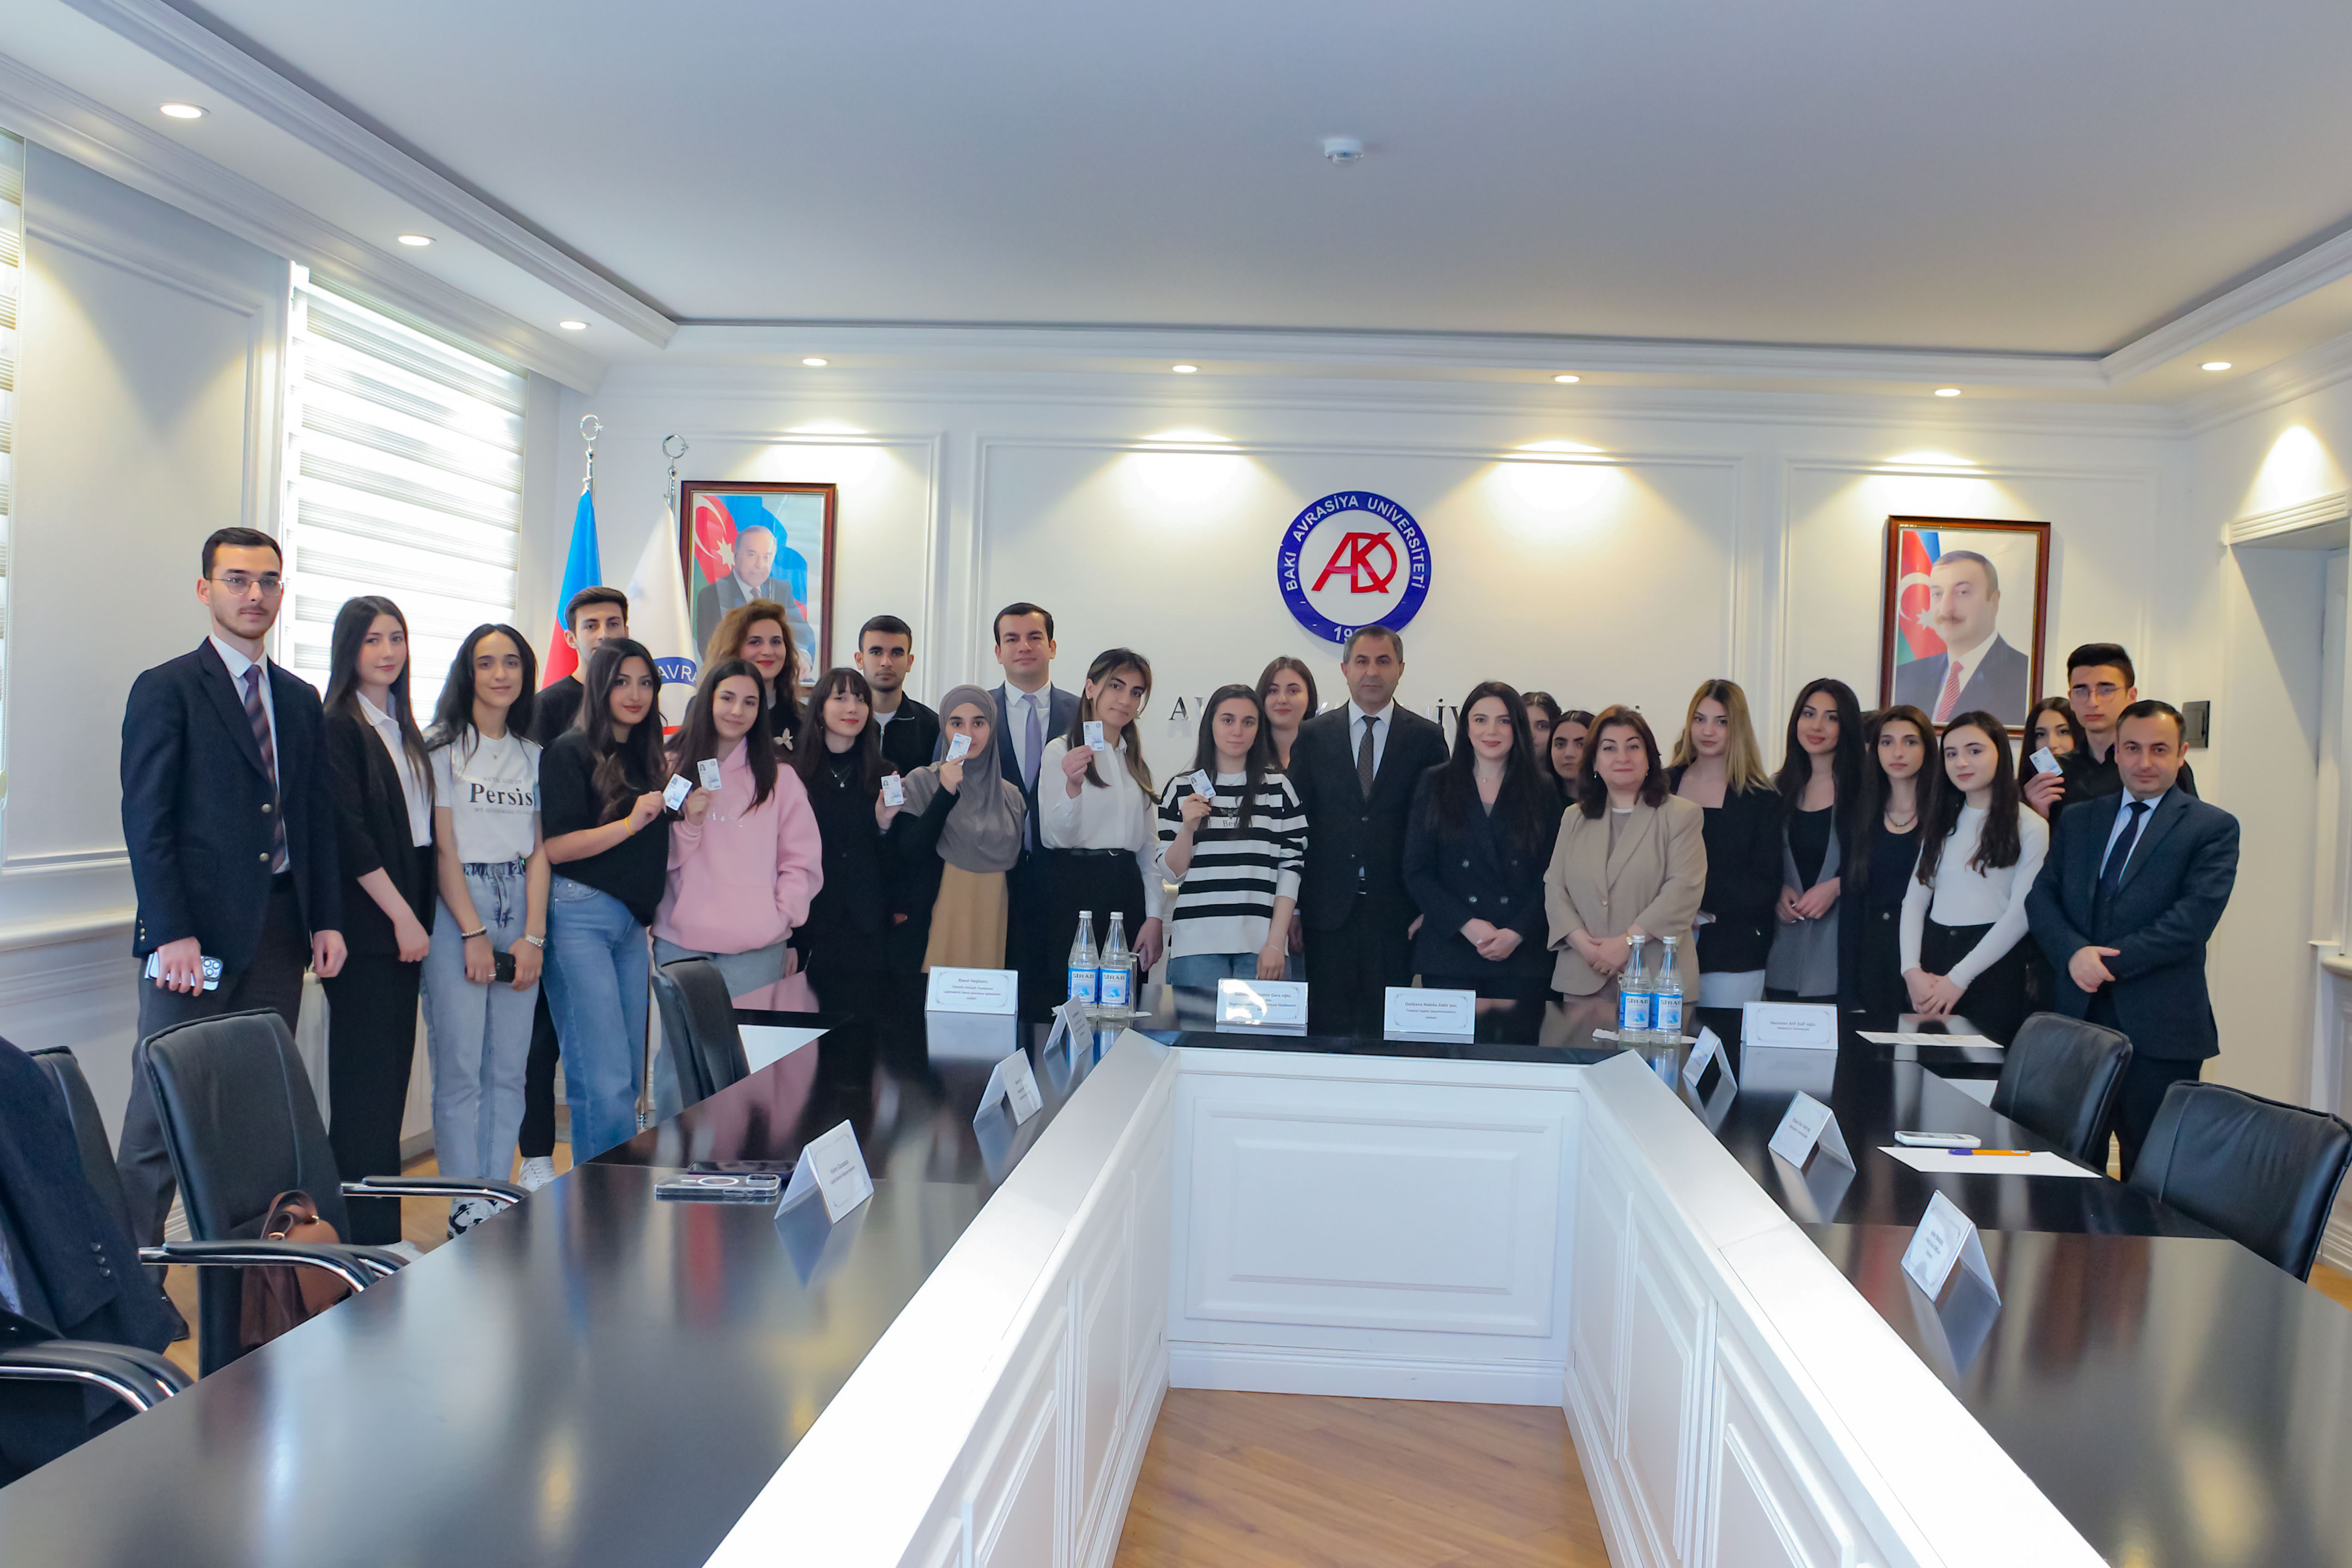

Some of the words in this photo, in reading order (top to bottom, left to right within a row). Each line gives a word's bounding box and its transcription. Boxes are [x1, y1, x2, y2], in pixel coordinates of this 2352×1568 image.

[1284, 552, 1298, 591] BAKI
[1293, 495, 1359, 542] AVRASİYA
[1367, 497, 1425, 589] UNİVERSİTETİ
[1334, 625, 1360, 642] 19
